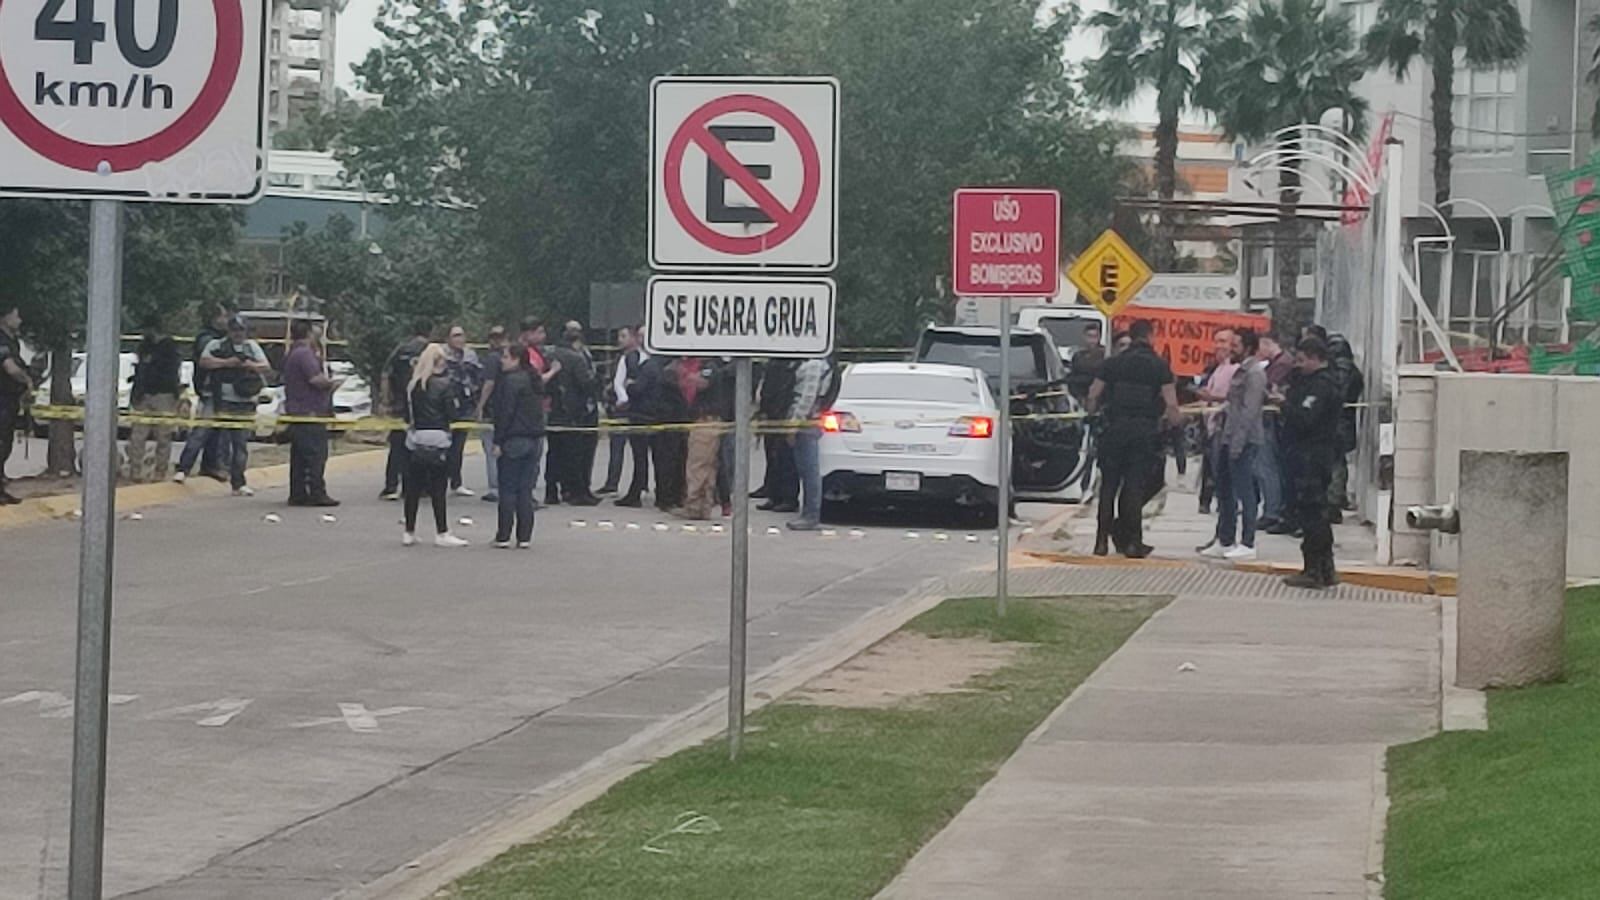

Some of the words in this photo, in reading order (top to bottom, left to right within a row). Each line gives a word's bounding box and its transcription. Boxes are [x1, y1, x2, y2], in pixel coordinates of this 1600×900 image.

[34, 0, 179, 68] 40
[35, 72, 174, 109] km/h
[706, 126, 776, 223] E
[993, 200, 1020, 221] USO
[971, 232, 1043, 253] EXCLUSIVO
[970, 263, 1042, 284] BOMBEROS
[1101, 265, 1118, 287] E
[663, 295, 688, 336] SE
[694, 295, 758, 336] USARA
[764, 296, 818, 337] GRUA
